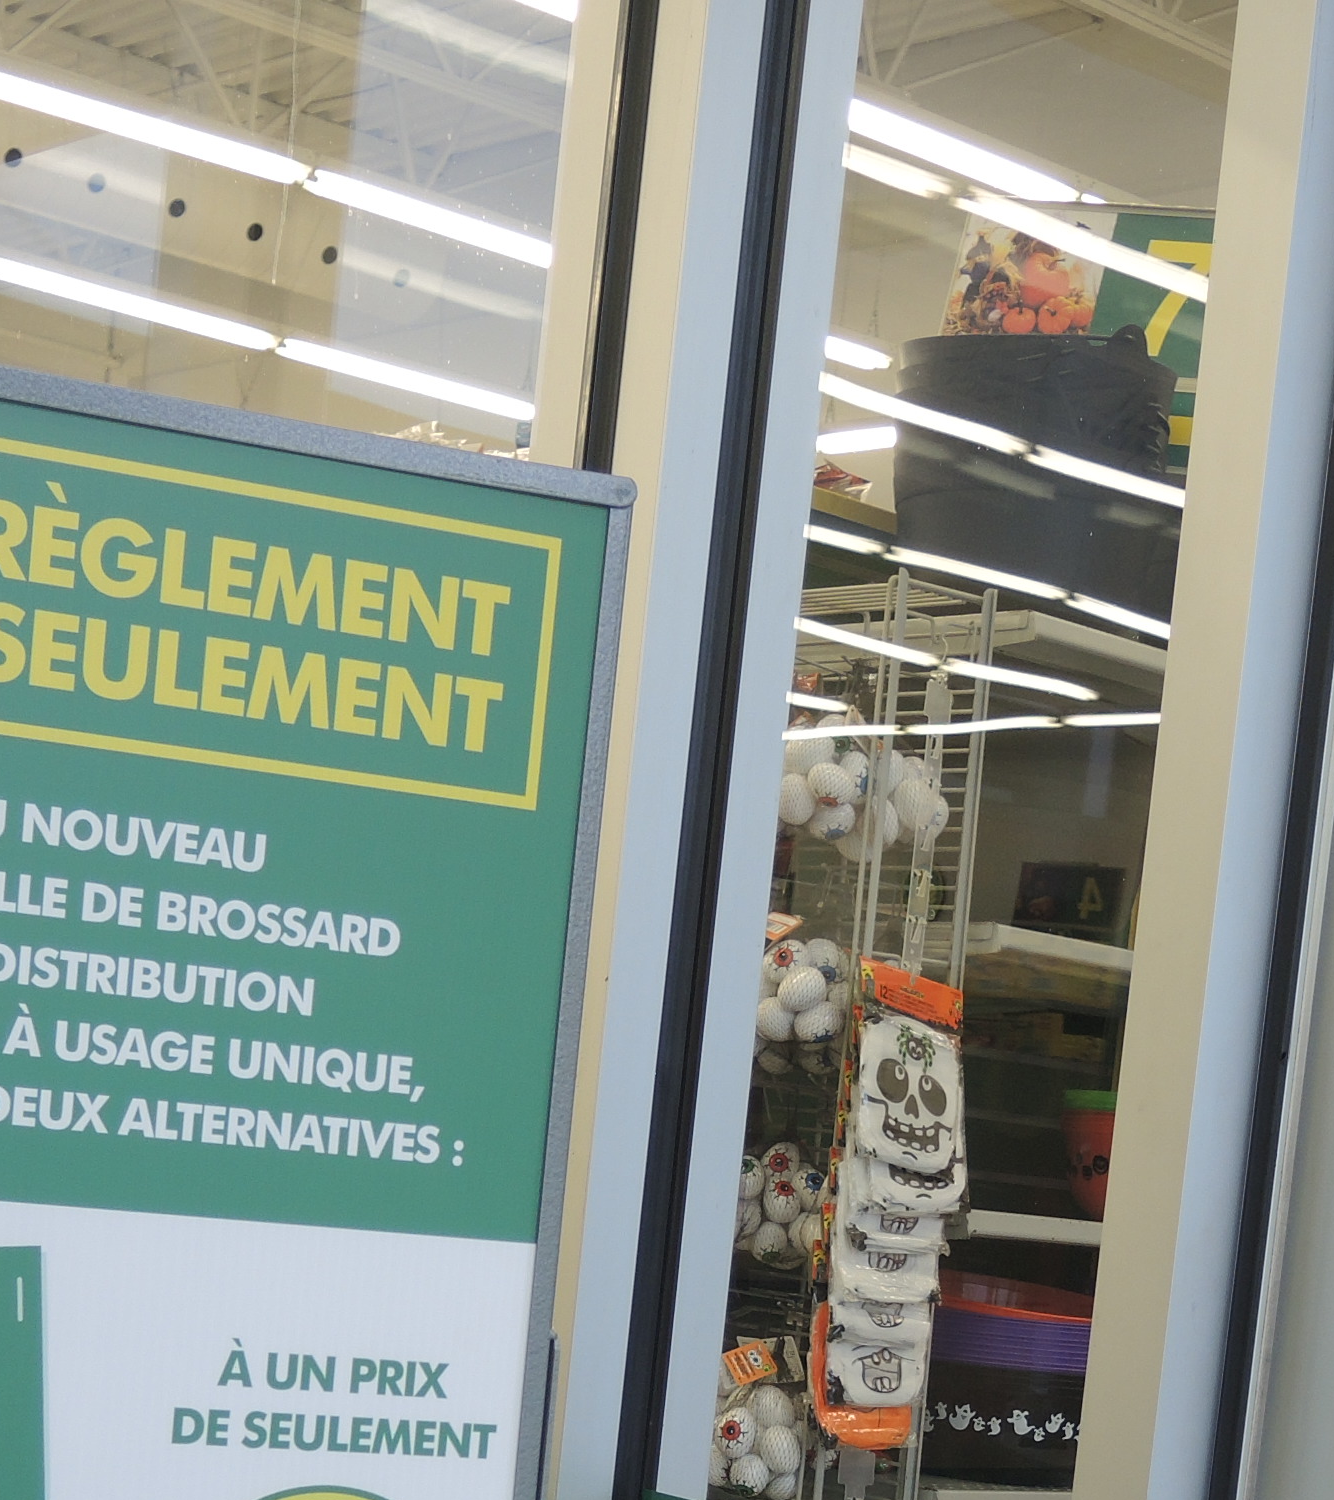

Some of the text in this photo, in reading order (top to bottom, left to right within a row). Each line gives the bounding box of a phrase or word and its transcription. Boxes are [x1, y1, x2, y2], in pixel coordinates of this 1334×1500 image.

[21, 803, 267, 873] NOUVEAU
[81, 882, 144, 929] DE
[156, 891, 401, 958] BROSSARD
[4, 1004, 41, 1059] À
[55, 1020, 216, 1076] USAGE
[228, 1039, 427, 1104] UNIQUE,
[117, 1097, 441, 1166] ALTERNATIVES
[217, 1338, 450, 1399] À UN PRIX
[171, 1408, 497, 1460] DE SEULEMENT
